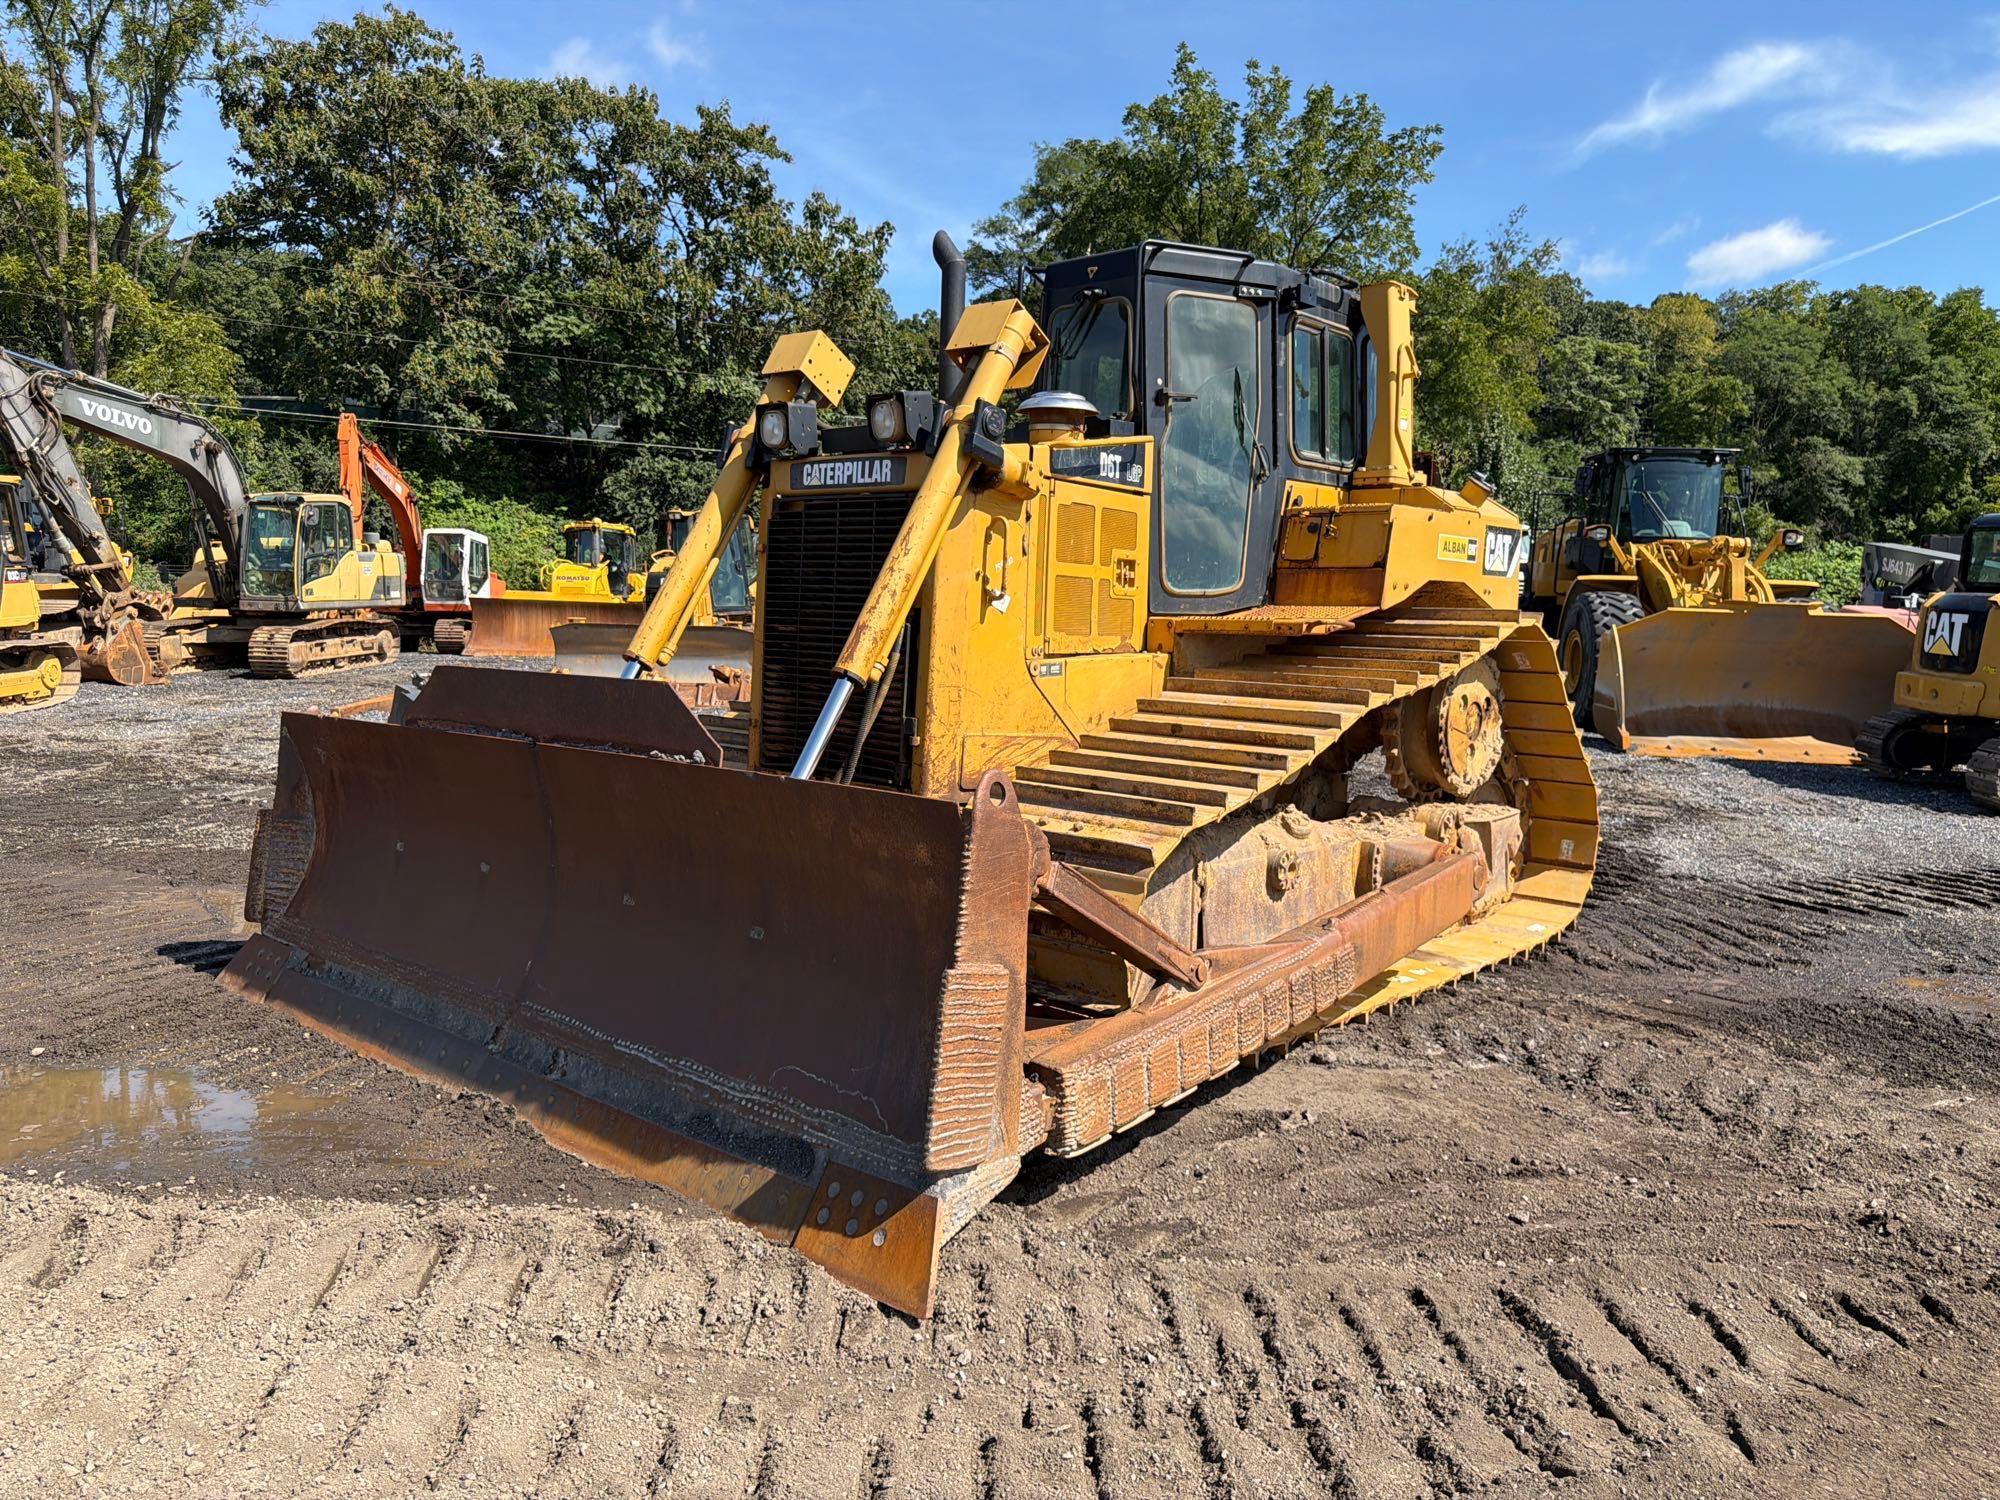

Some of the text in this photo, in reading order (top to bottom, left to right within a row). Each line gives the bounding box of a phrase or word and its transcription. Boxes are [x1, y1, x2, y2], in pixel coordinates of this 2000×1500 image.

[79, 397, 152, 434] VOLVO
[803, 460, 892, 486] CATERPILLAR
[1100, 451, 1122, 479] D6T
[1442, 541, 1467, 554] ALBAN
[1484, 532, 1512, 572] CAT
[1923, 610, 1969, 657] CAT
